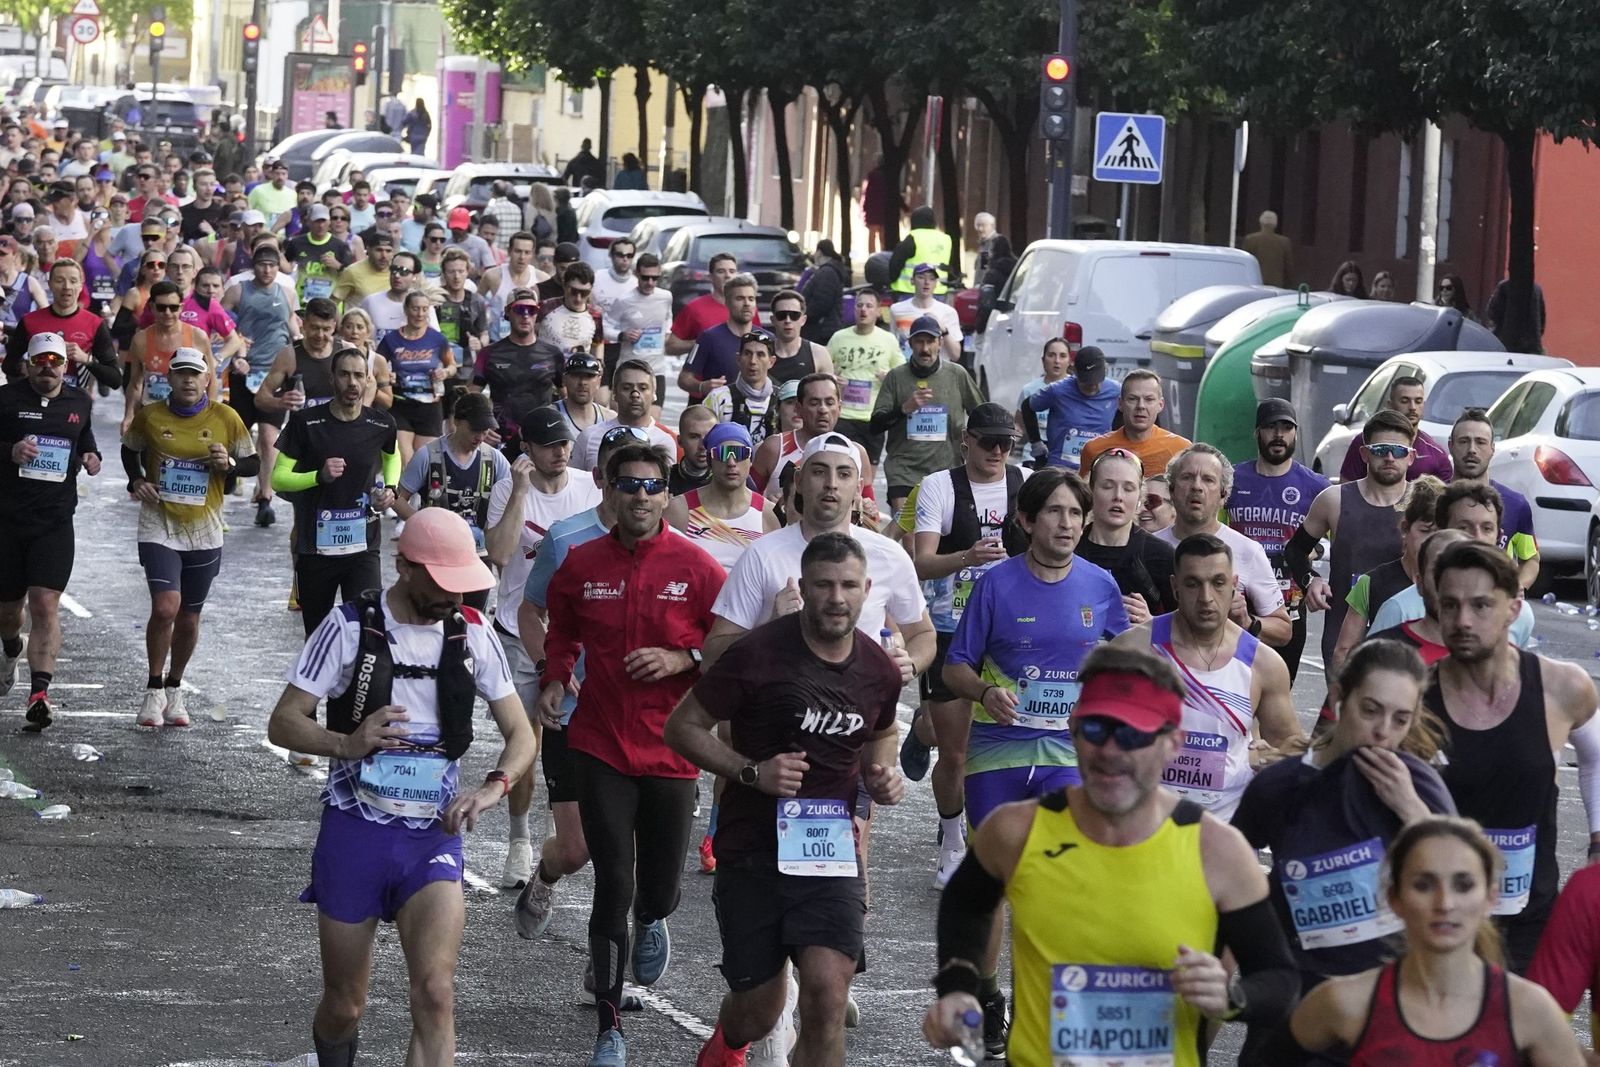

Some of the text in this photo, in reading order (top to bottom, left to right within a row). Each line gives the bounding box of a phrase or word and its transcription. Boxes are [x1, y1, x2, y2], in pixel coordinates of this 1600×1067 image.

[78, 25, 96, 36] 30
[916, 425, 938, 433] MANU
[40, 437, 67, 446] ZURICH
[27, 459, 62, 471] HASSEL
[177, 461, 206, 470] ZURICH
[160, 481, 207, 495] EL CUERPO
[334, 511, 361, 520] ZURICH
[335, 525, 351, 533] 9340
[1244, 526, 1286, 538] ALCONCHEL
[332, 534, 353, 545] TONI
[1043, 688, 1065, 699] 5739
[800, 707, 865, 736] WILD
[1184, 736, 1220, 748] URICH
[392, 765, 416, 777] 7041
[402, 788, 440, 801] RUNNER
[806, 804, 845, 815] ZURICH
[806, 828, 829, 838] 8007
[1488, 833, 1531, 846] URICH
[803, 839, 836, 858] LOÏC
[1311, 846, 1372, 873] ZURICH
[1322, 881, 1354, 898] 6923
[1498, 873, 1530, 894] IETO
[1094, 971, 1164, 988] ZURICH
[1096, 1005, 1132, 1021] 5851
[1057, 1026, 1169, 1050] CHAPOLIN
